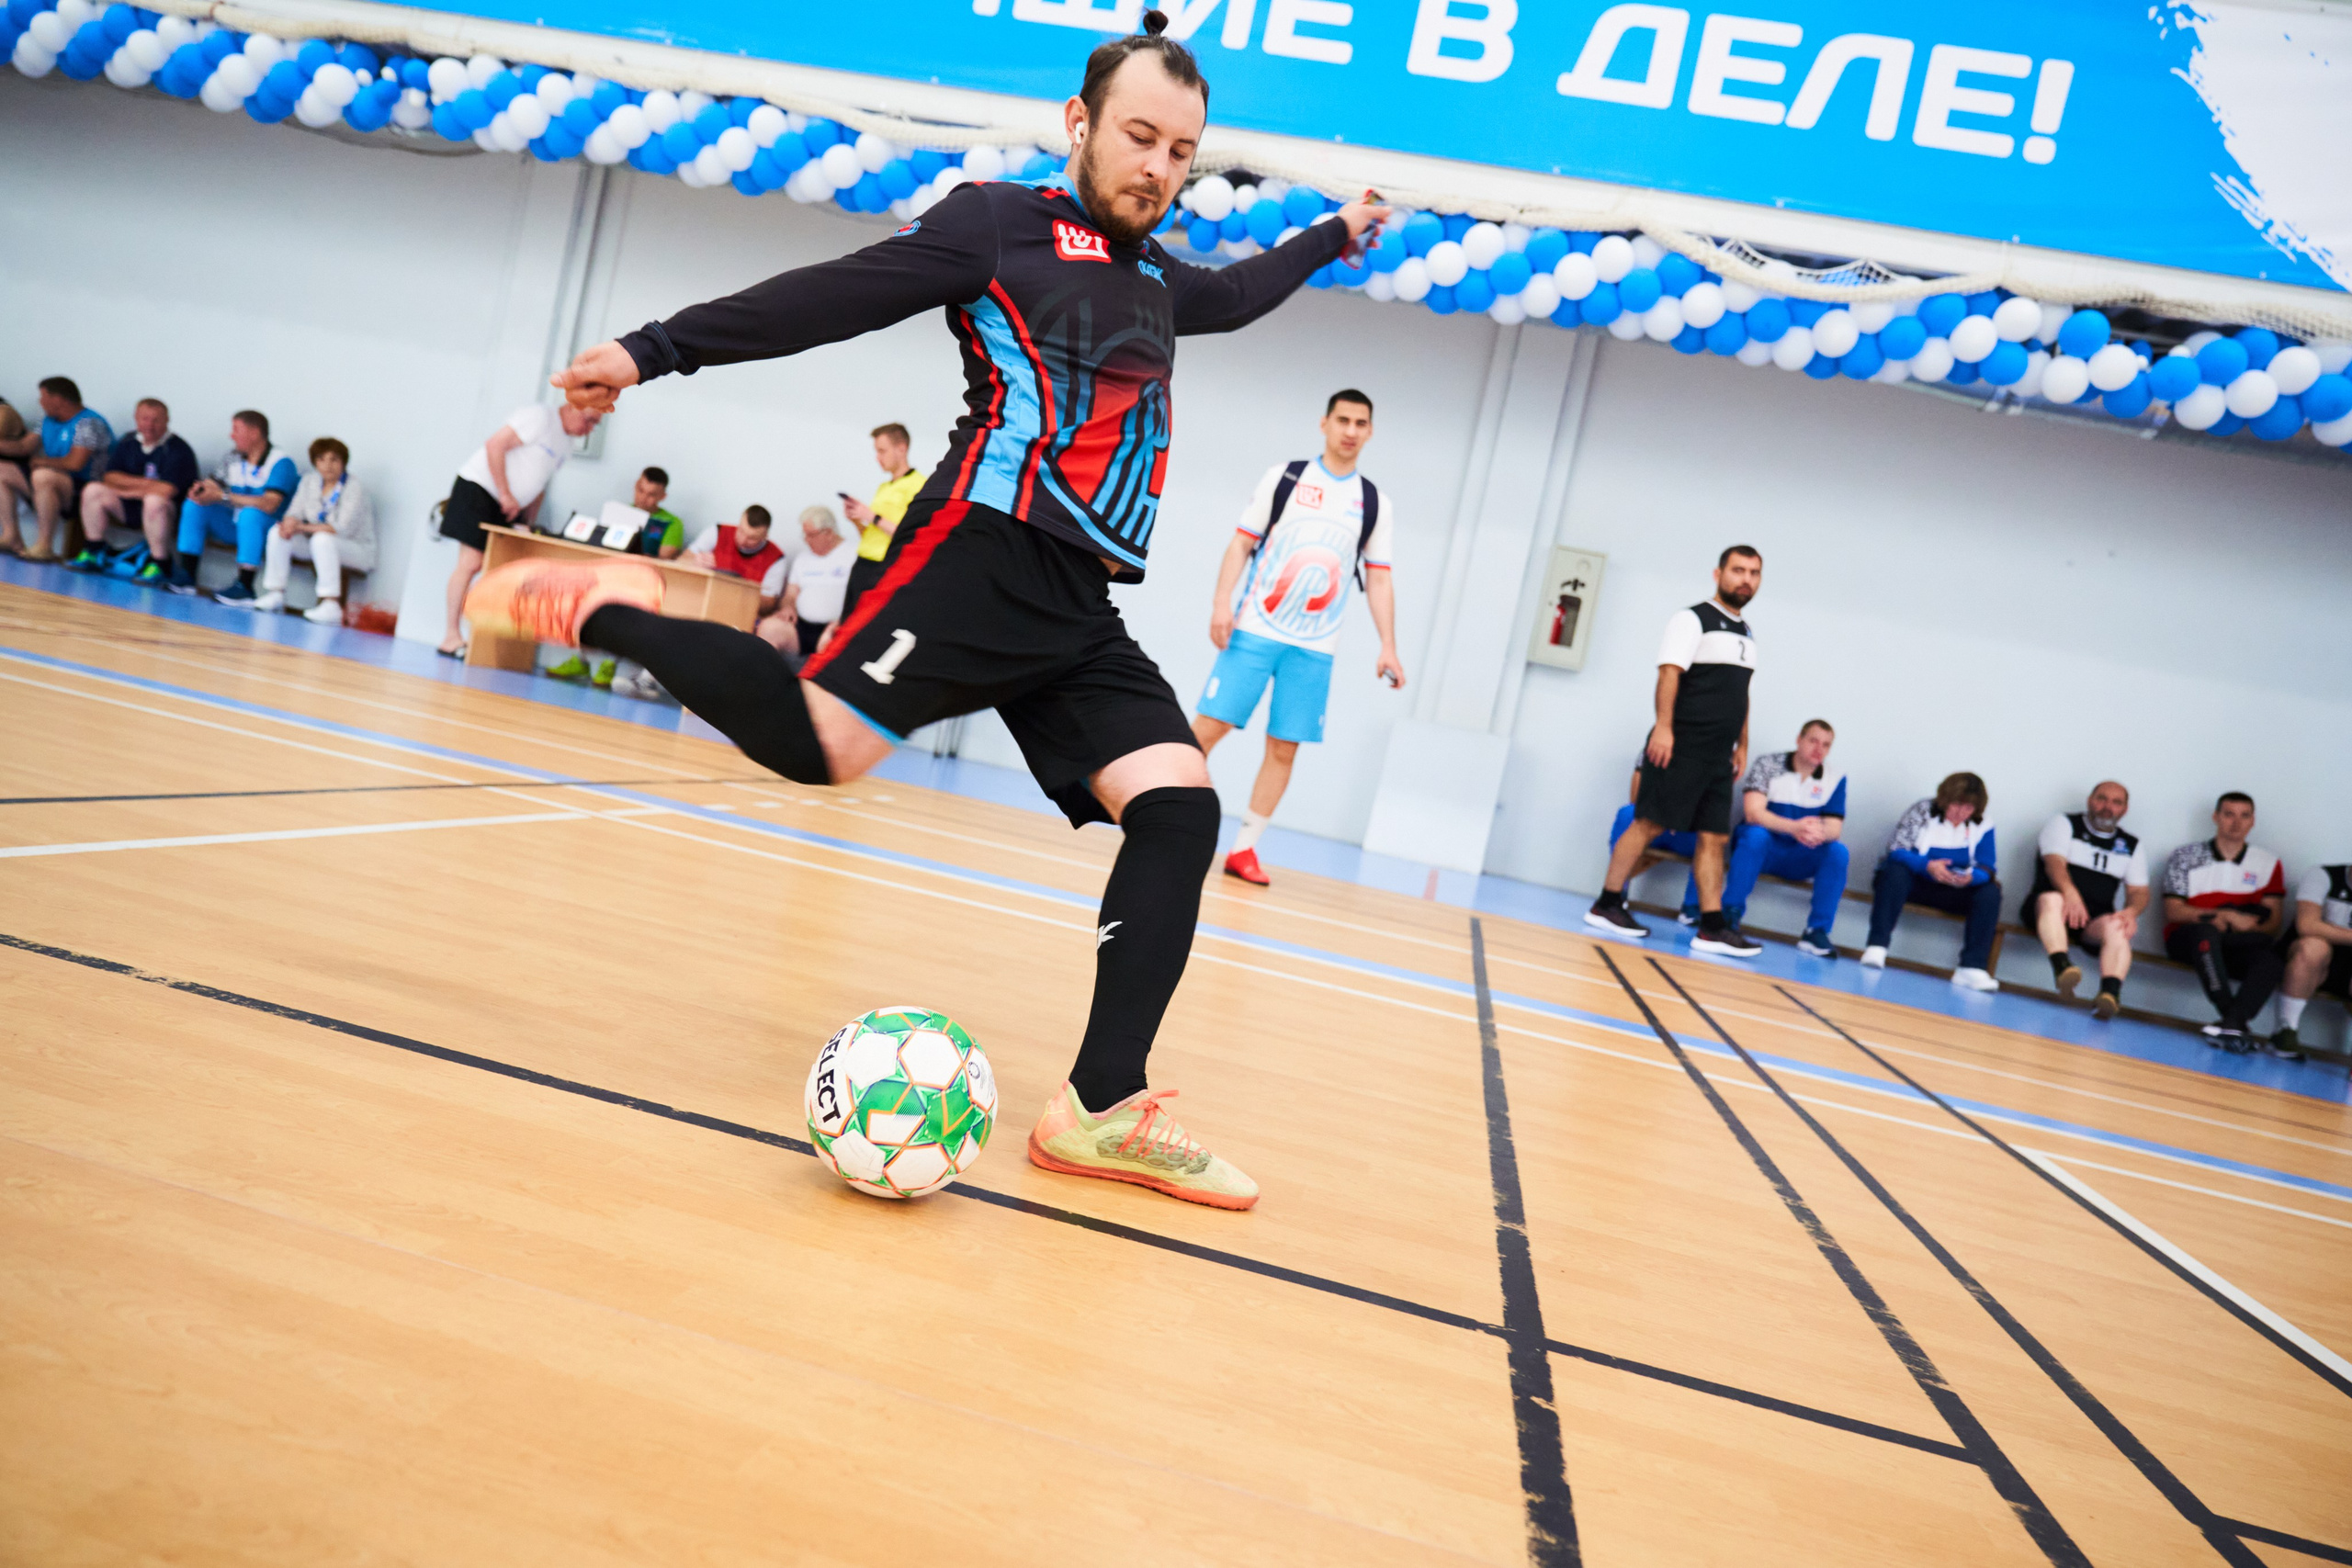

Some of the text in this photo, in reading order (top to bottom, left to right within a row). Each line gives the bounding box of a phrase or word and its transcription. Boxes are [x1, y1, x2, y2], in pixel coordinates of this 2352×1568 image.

[1407, 0, 1519, 83] В
[1555, 3, 2075, 165] ДЕЛЕ!
[860, 628, 917, 684] 1
[1737, 639, 1747, 661] 2
[2093, 851, 2109, 871] 11
[817, 1027, 848, 1123] SELECT
